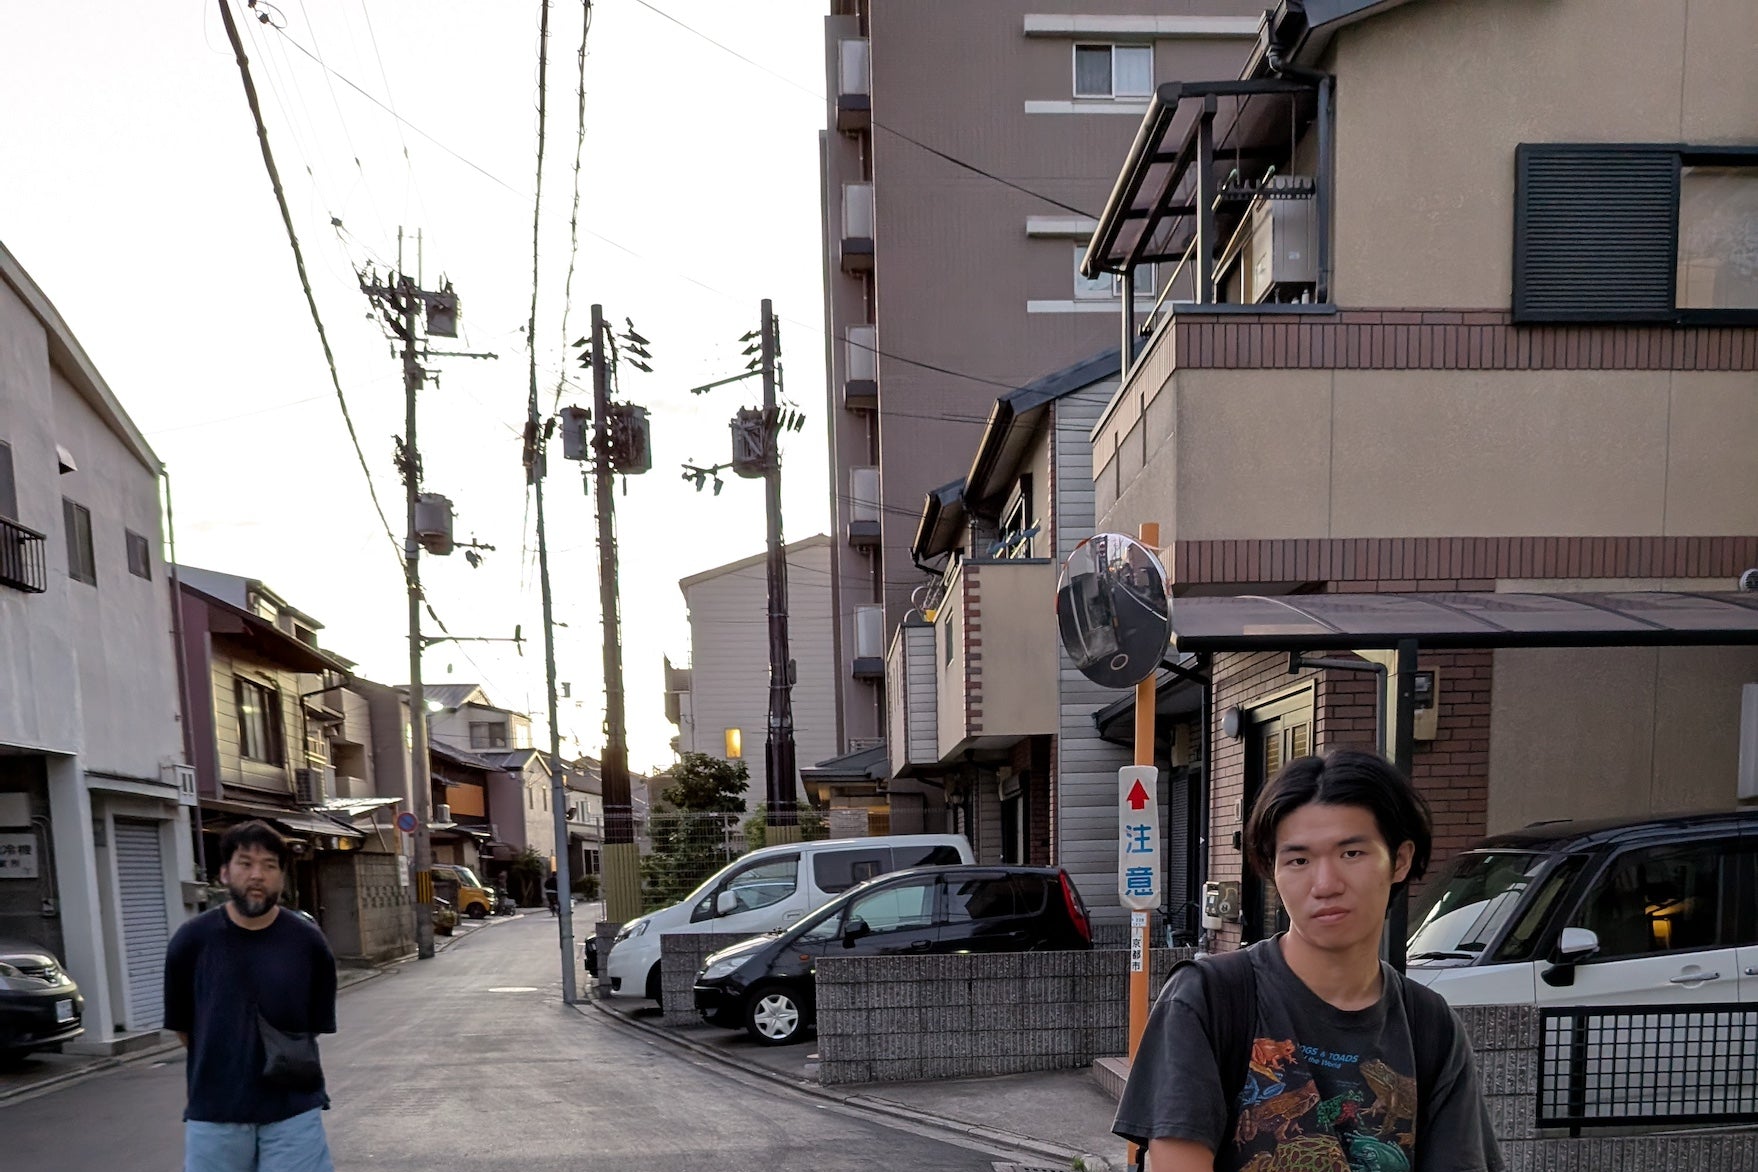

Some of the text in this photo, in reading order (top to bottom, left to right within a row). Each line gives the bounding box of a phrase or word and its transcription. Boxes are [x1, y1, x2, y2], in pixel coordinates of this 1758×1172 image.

[1125, 824, 1153, 896] 注意
[1132, 938, 1142, 971] 京都市
[1299, 1045, 1319, 1056] OGS
[1329, 1053, 1359, 1063] TOADS
